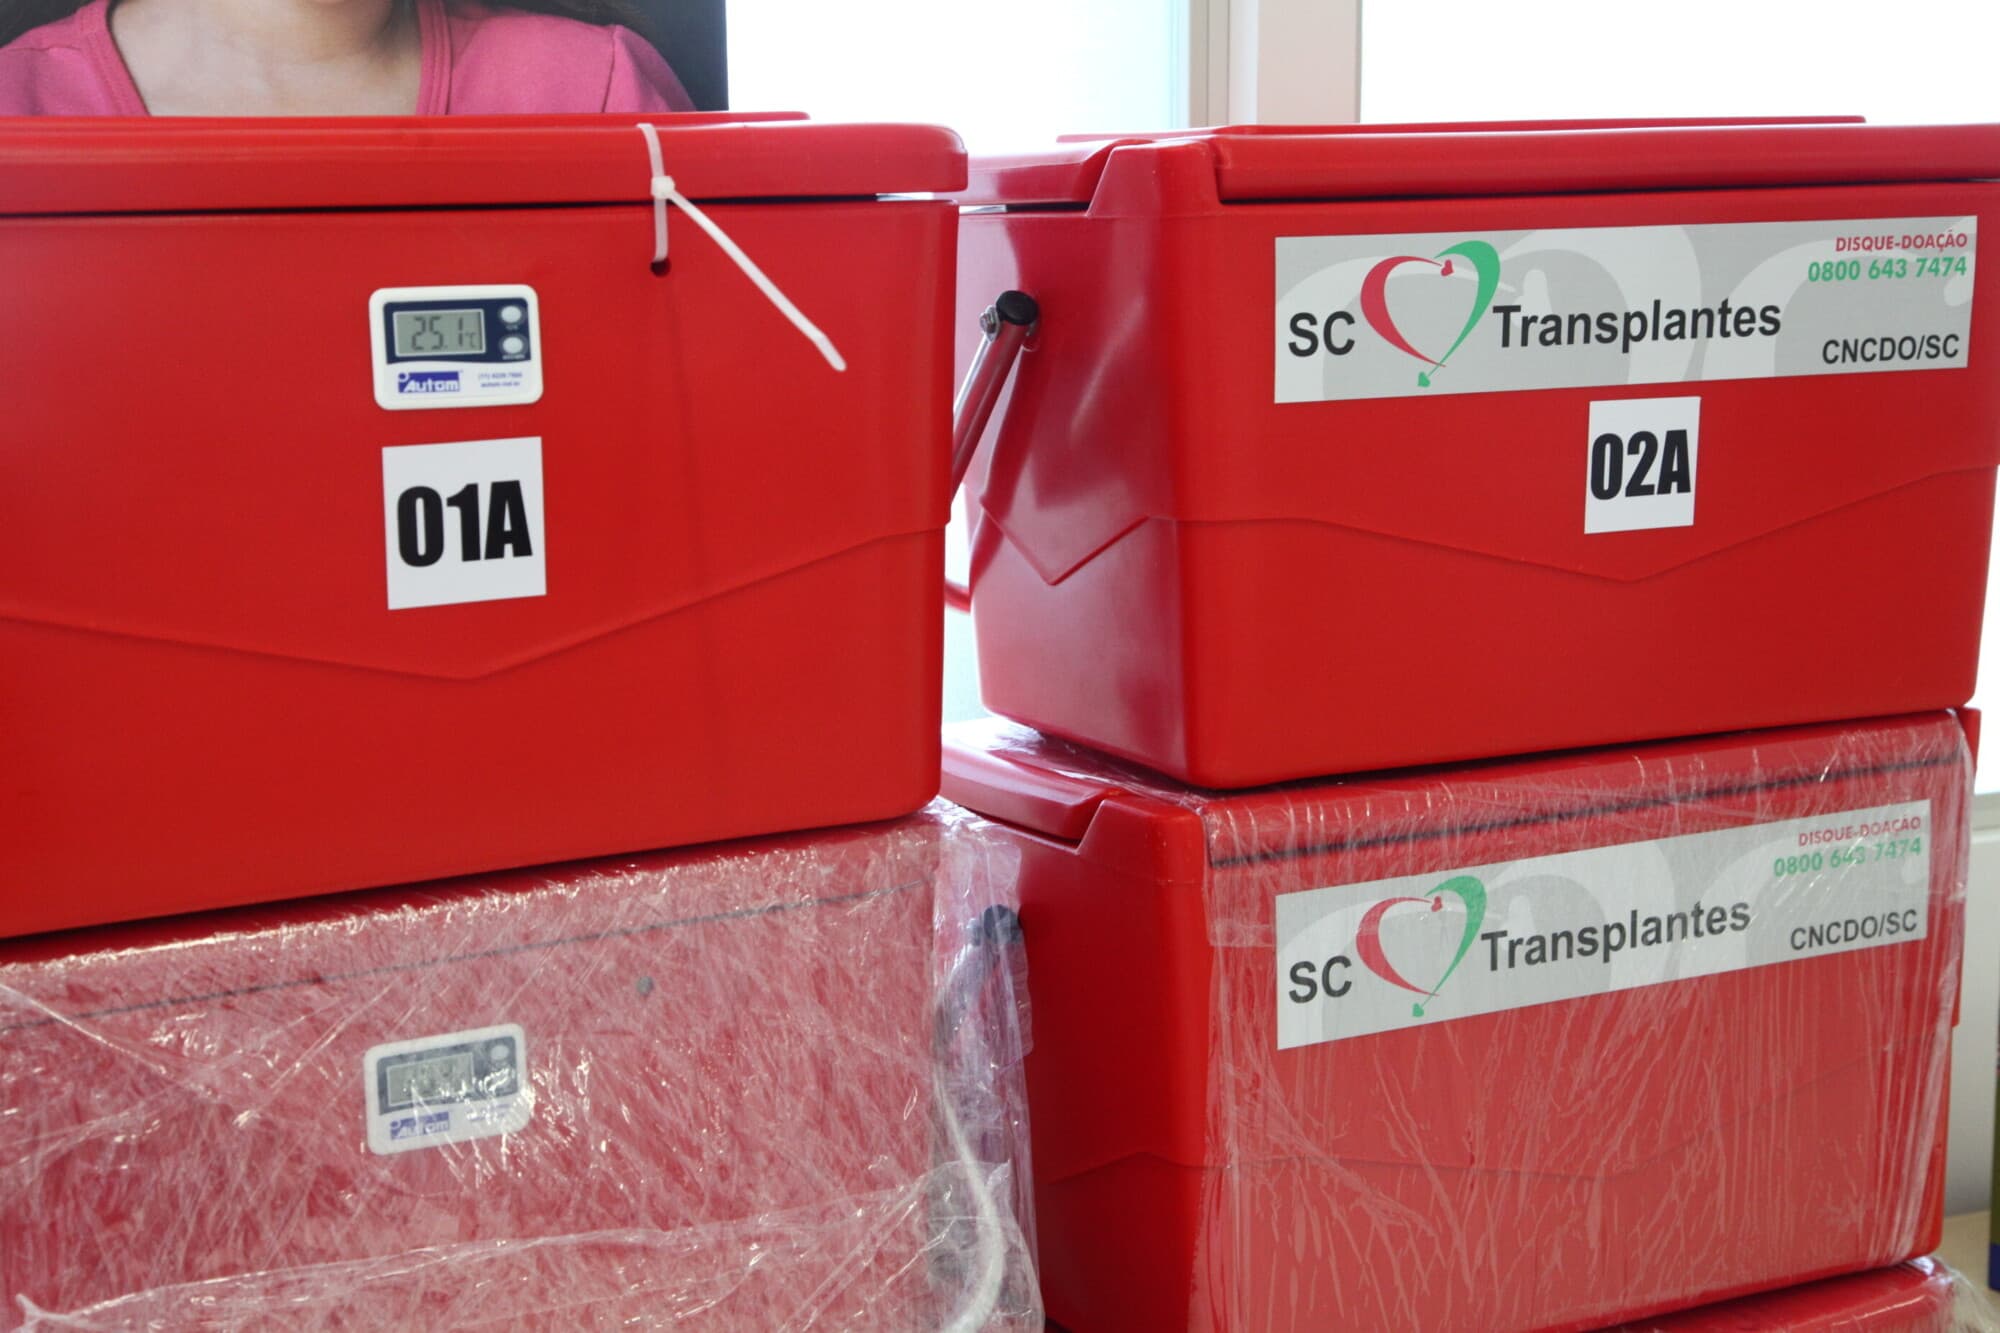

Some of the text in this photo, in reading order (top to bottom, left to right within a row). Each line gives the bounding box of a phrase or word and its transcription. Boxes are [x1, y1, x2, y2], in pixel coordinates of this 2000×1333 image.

[1835, 230, 1968, 252] DISQUE-DOAÇÃO
[1808, 256, 1967, 282] 0800 643 7474
[1287, 297, 1782, 358] SC Transplantes
[1821, 333, 1960, 365] CNCDO/SC
[1590, 429, 1691, 500] 02A
[397, 480, 533, 568] 01A
[1773, 837, 1921, 877] 0800 643 7474
[1288, 898, 1750, 1005] SC Transplantes
[1790, 909, 1918, 952] CNCDO/SC
